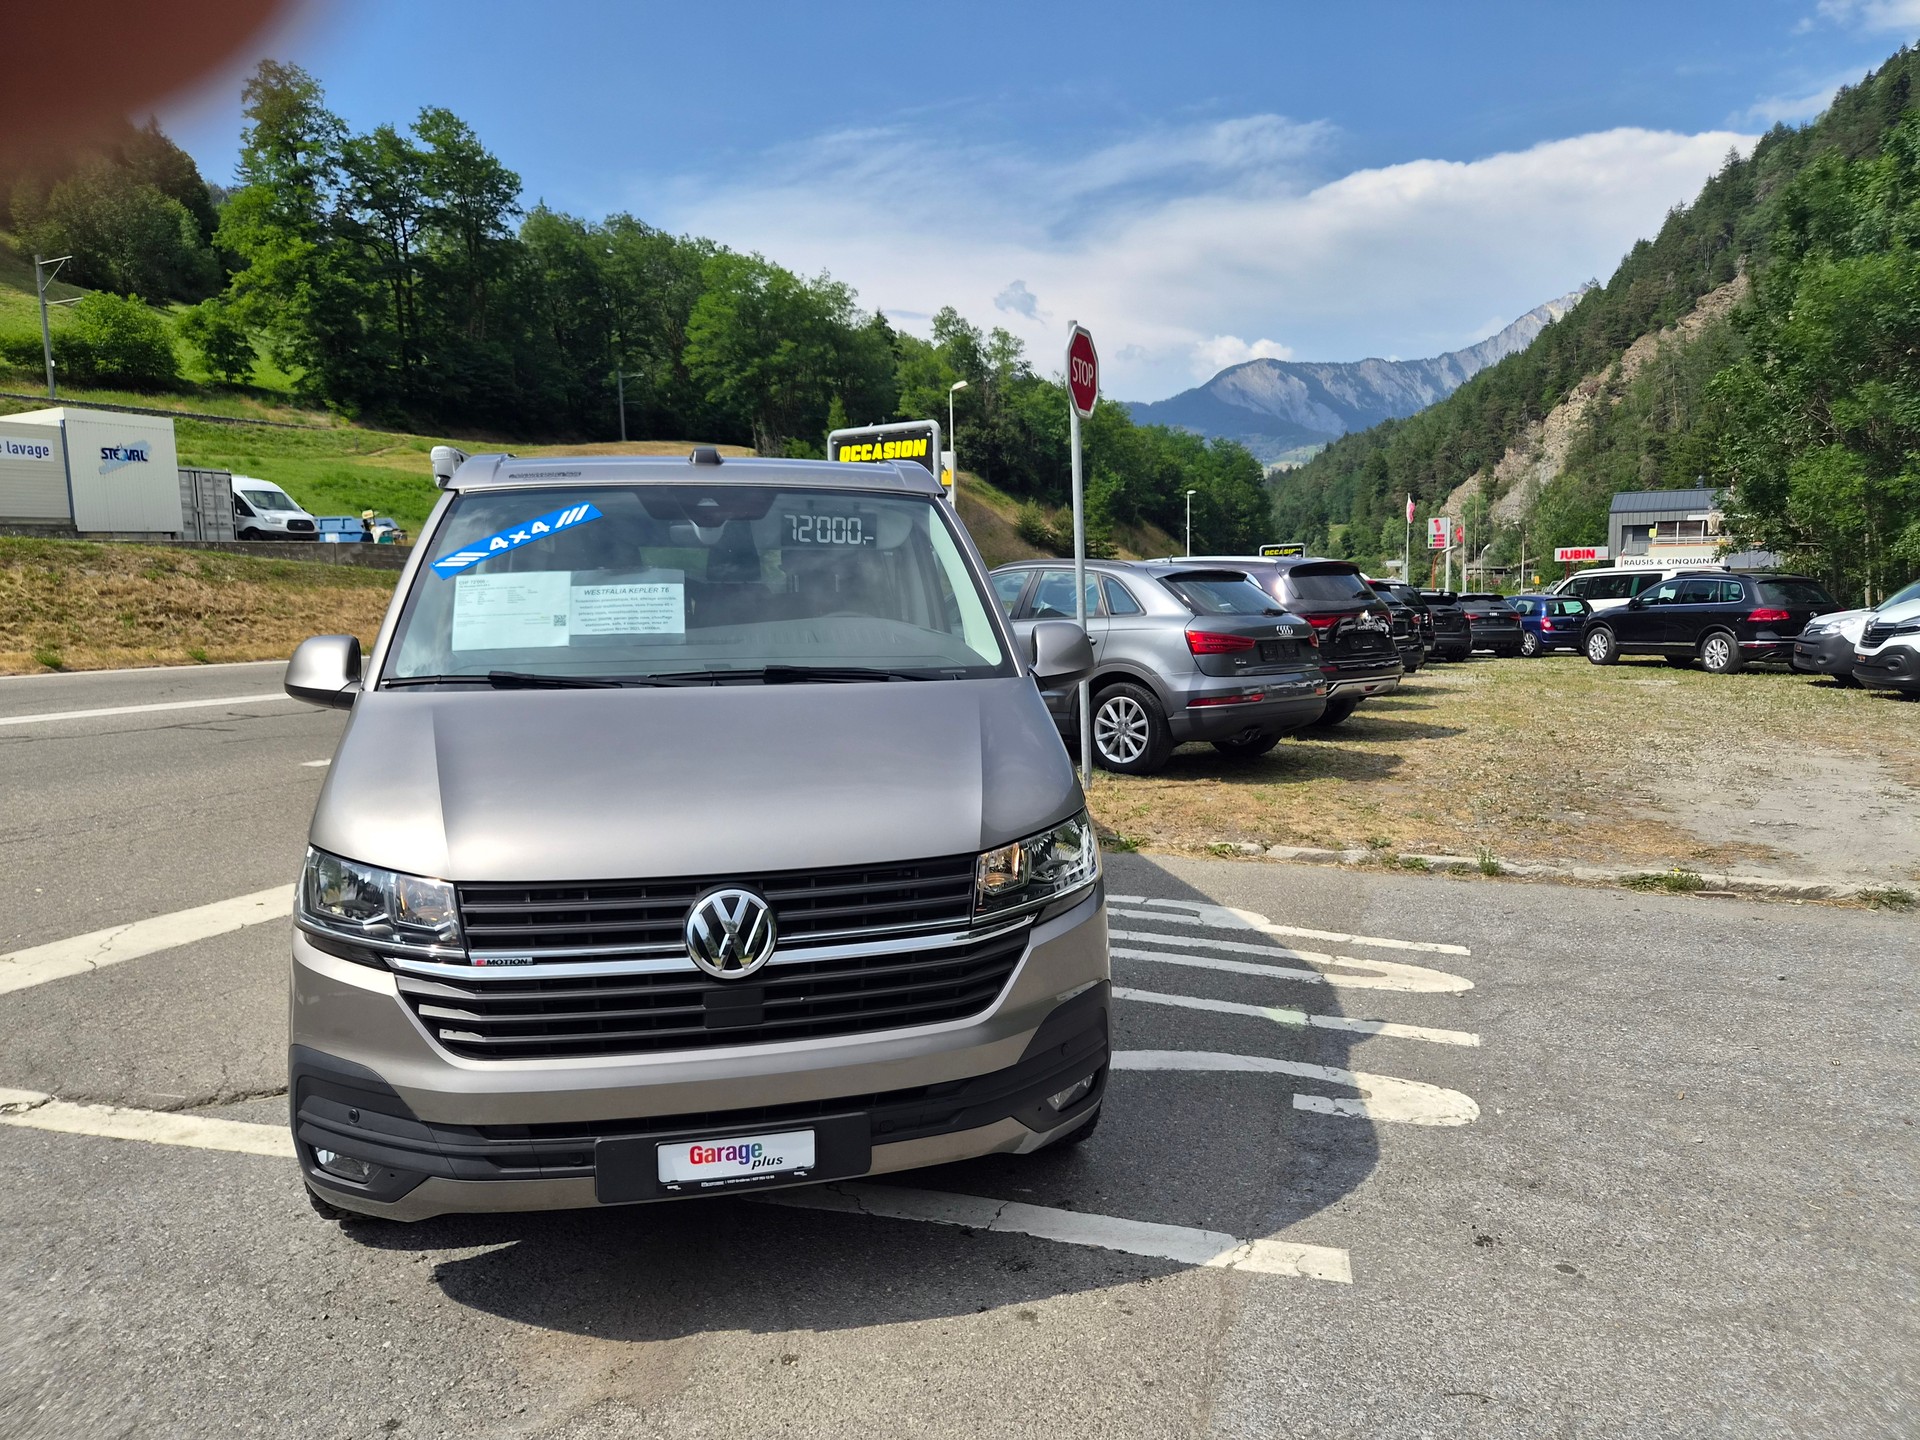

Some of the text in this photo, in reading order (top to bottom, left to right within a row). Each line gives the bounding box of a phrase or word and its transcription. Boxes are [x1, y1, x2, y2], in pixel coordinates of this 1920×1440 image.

[1072, 356, 1094, 388] STOP
[6, 441, 50, 459] lavage
[839, 439, 927, 463] OCCASION
[1264, 548, 1302, 556] OCCASIO
[1560, 549, 1596, 560] JUBIN
[584, 588, 627, 596] WESTFALIA
[628, 587, 659, 595] KEPLER
[689, 1142, 763, 1165] Garage
[751, 1155, 784, 1170] plus
